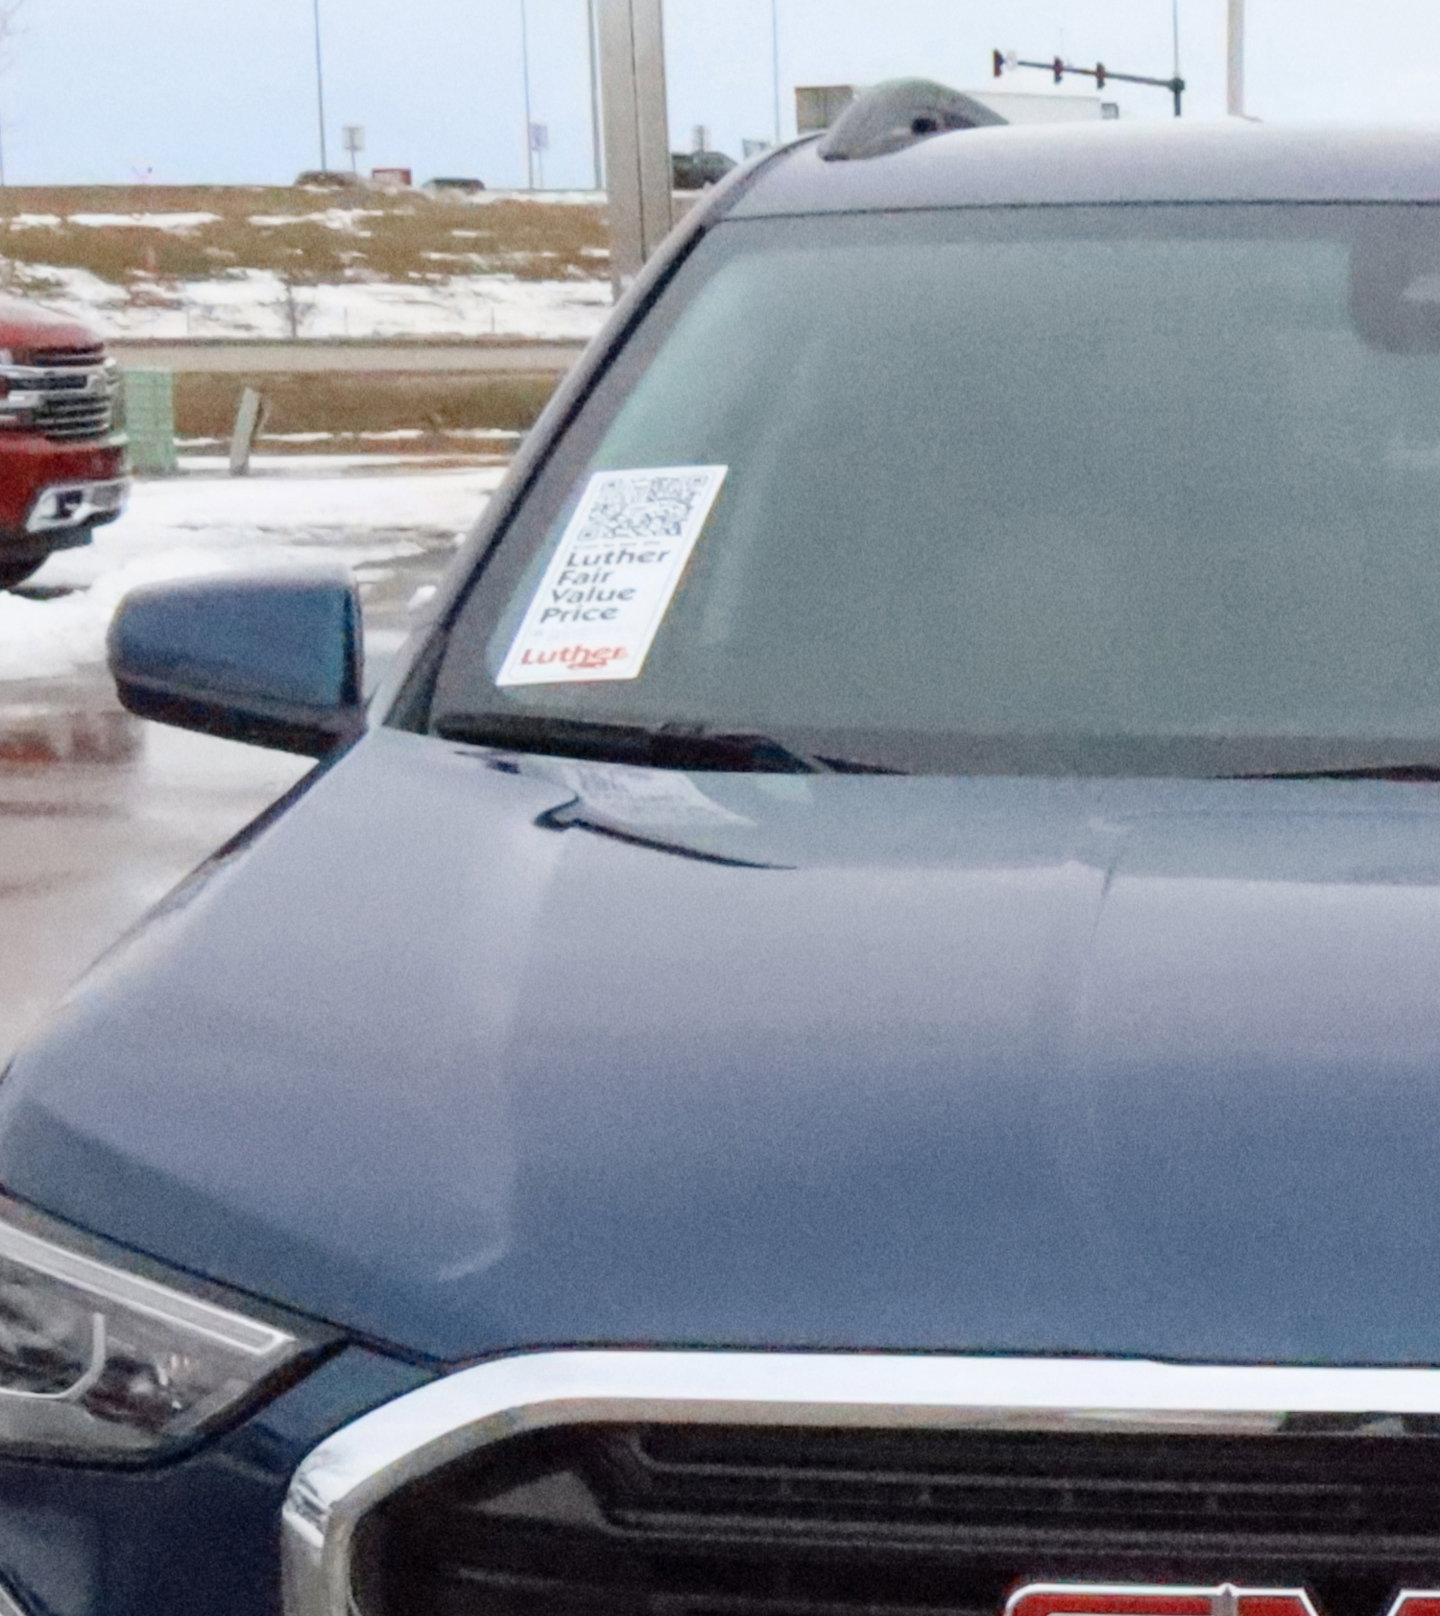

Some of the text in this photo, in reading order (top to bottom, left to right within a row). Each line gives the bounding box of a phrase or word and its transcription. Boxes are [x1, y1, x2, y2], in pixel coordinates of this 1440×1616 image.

[566, 549, 670, 568] Luther
[557, 567, 614, 586] Fair
[551, 586, 637, 605] Value
[539, 604, 620, 625] Price
[520, 645, 630, 666] Luther
